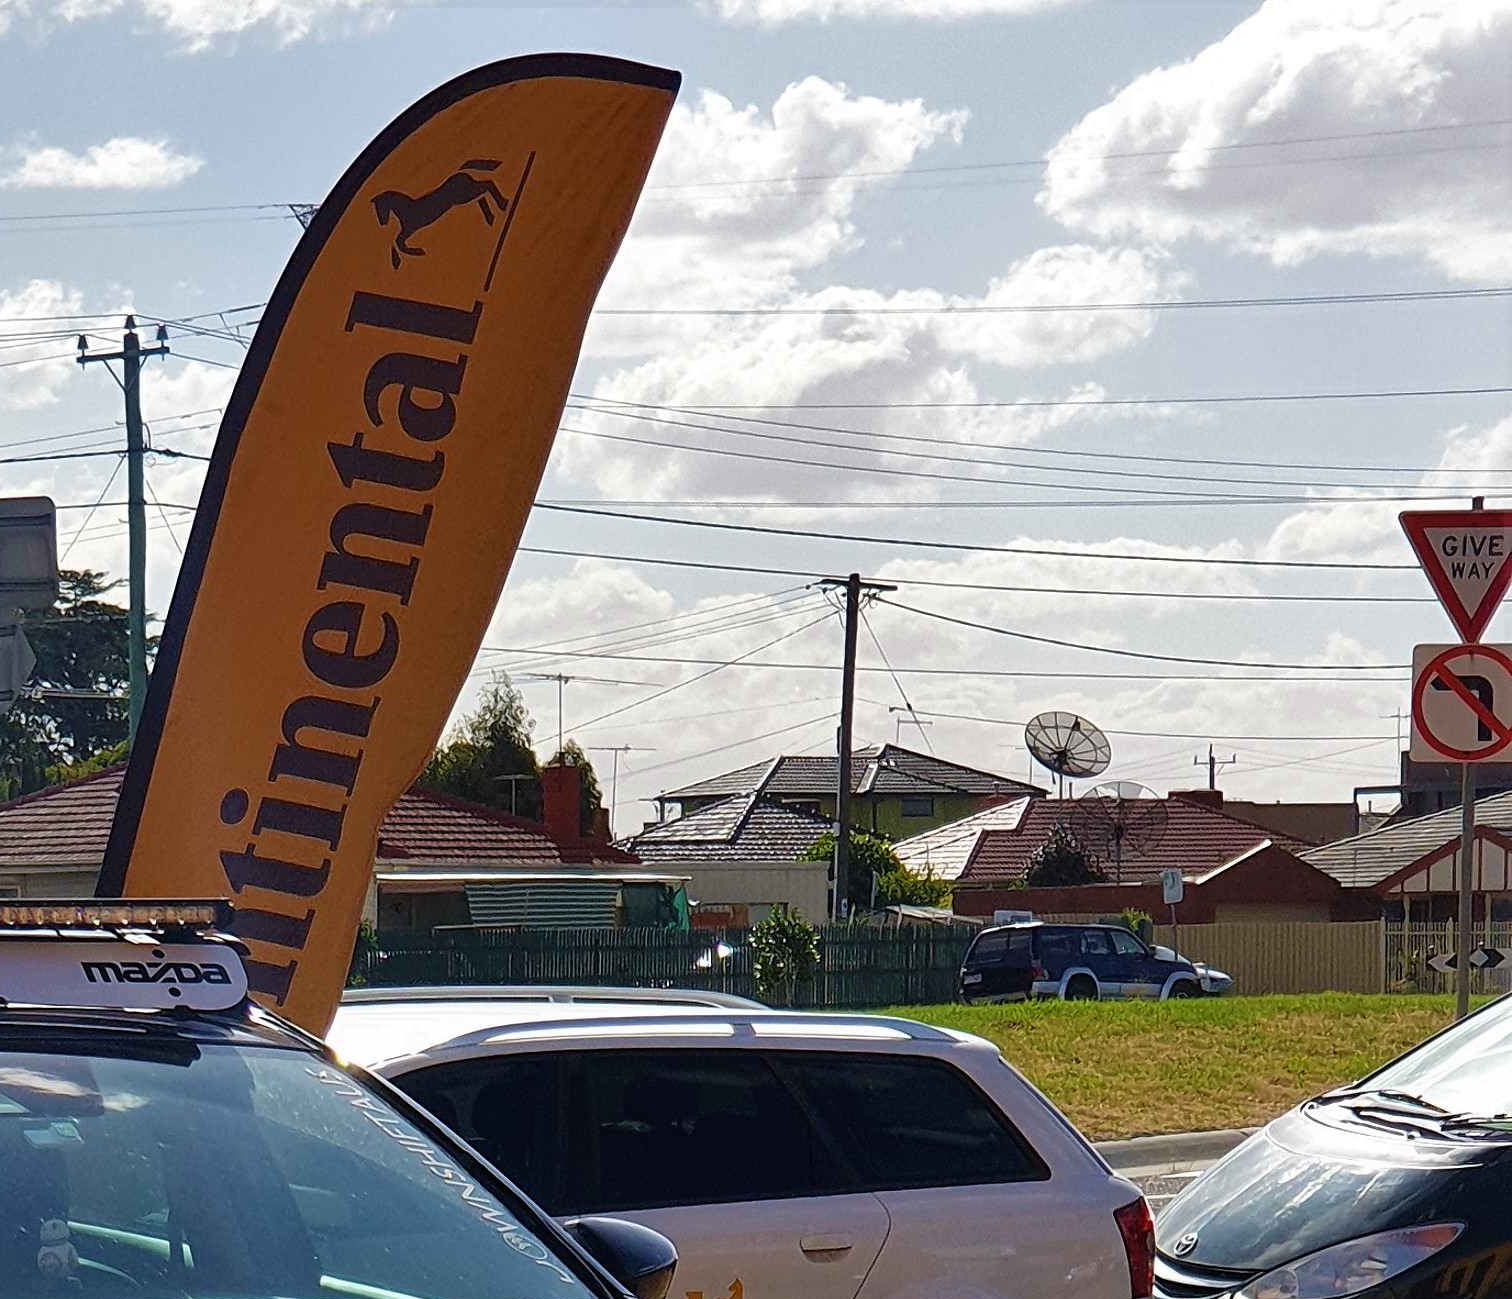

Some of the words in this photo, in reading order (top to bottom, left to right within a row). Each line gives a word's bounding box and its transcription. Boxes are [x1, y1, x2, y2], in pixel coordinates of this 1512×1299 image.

[1441, 535, 1504, 557] GIVE
[1451, 561, 1495, 579] WAY
[219, 289, 484, 1007] ntinental
[80, 960, 233, 985] mazda
